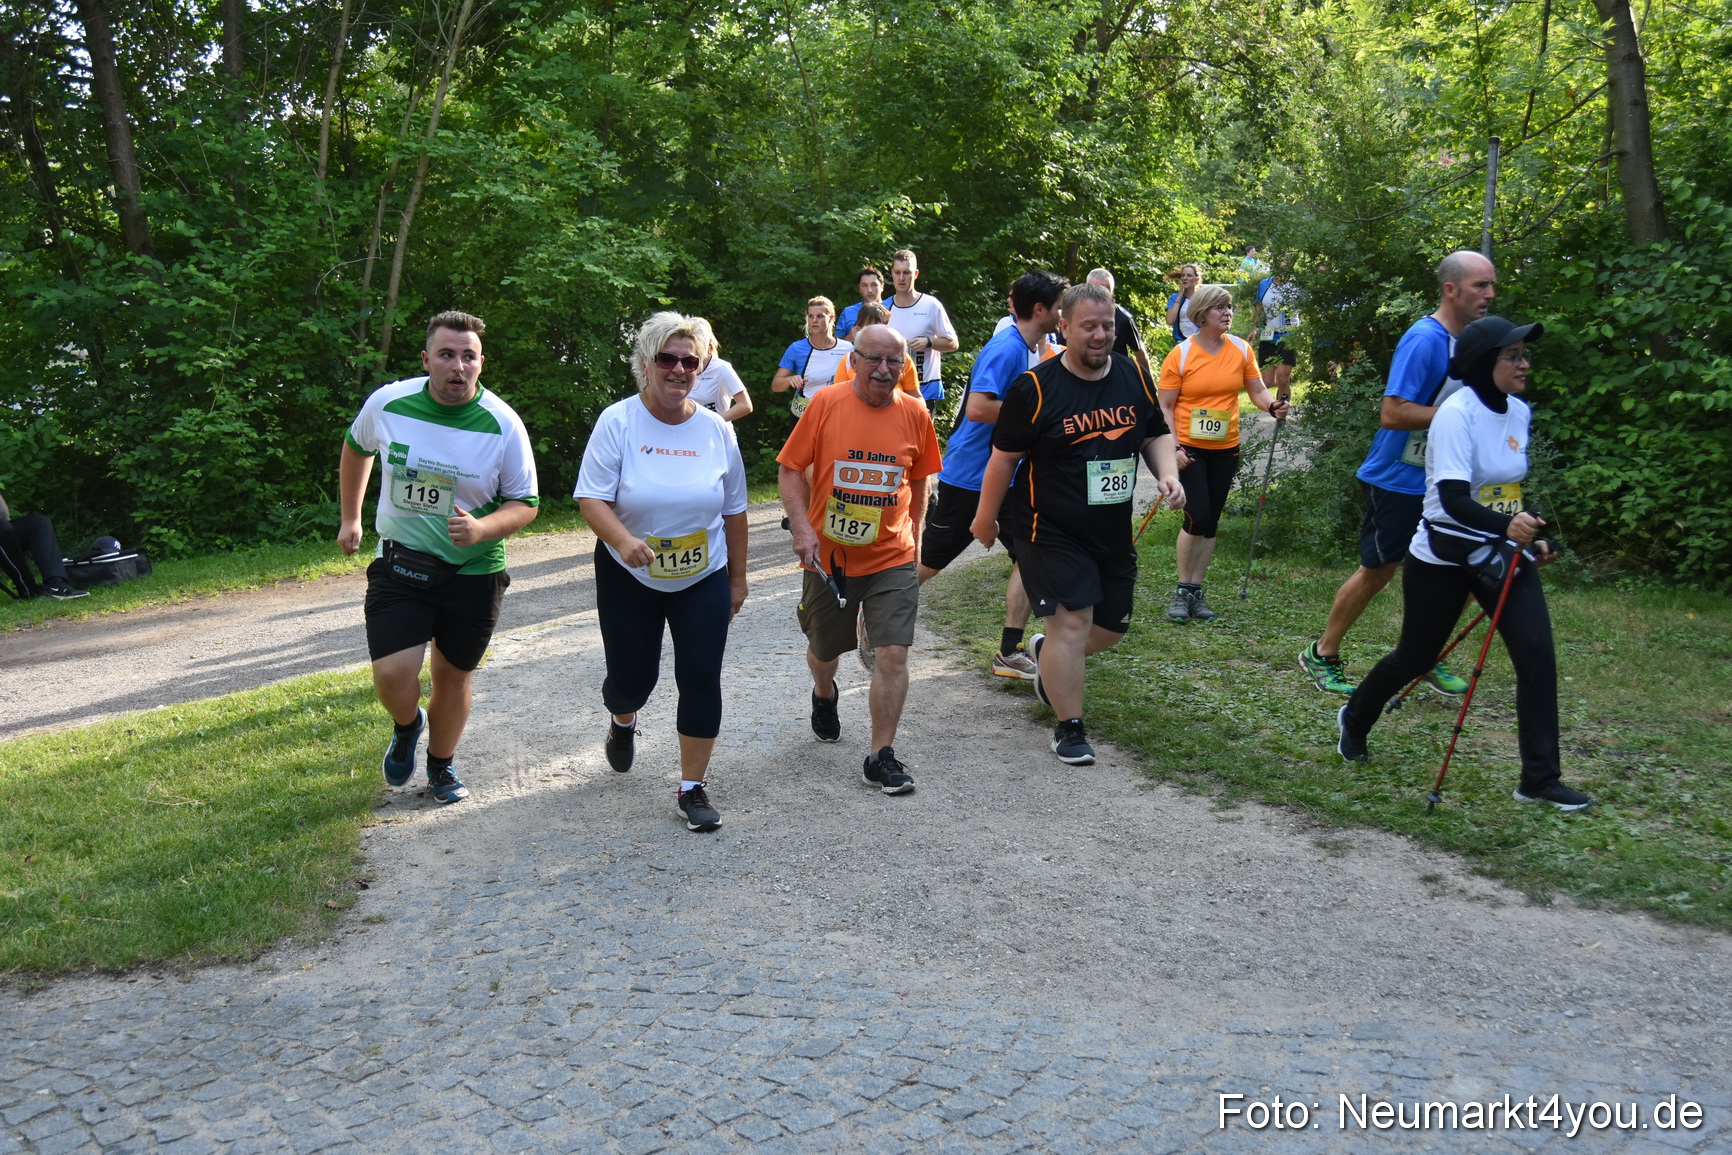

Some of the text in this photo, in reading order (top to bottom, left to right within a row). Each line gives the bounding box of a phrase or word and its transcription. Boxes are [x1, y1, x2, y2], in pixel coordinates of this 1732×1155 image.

[1063, 417, 1076, 435] BIT
[1073, 405, 1136, 432] WINGS
[1198, 419, 1221, 432] 109
[656, 448, 700, 457] KLEBL
[848, 449, 896, 464] 30 Jahre
[418, 457, 459, 470] BayWa Baustoffe
[839, 466, 898, 487] OBI
[1100, 475, 1128, 493] 288
[404, 483, 440, 505] 119
[832, 488, 898, 507] Neumarkt
[830, 513, 872, 537] 1187
[656, 546, 702, 568] 1145
[392, 564, 429, 582] GRACE
